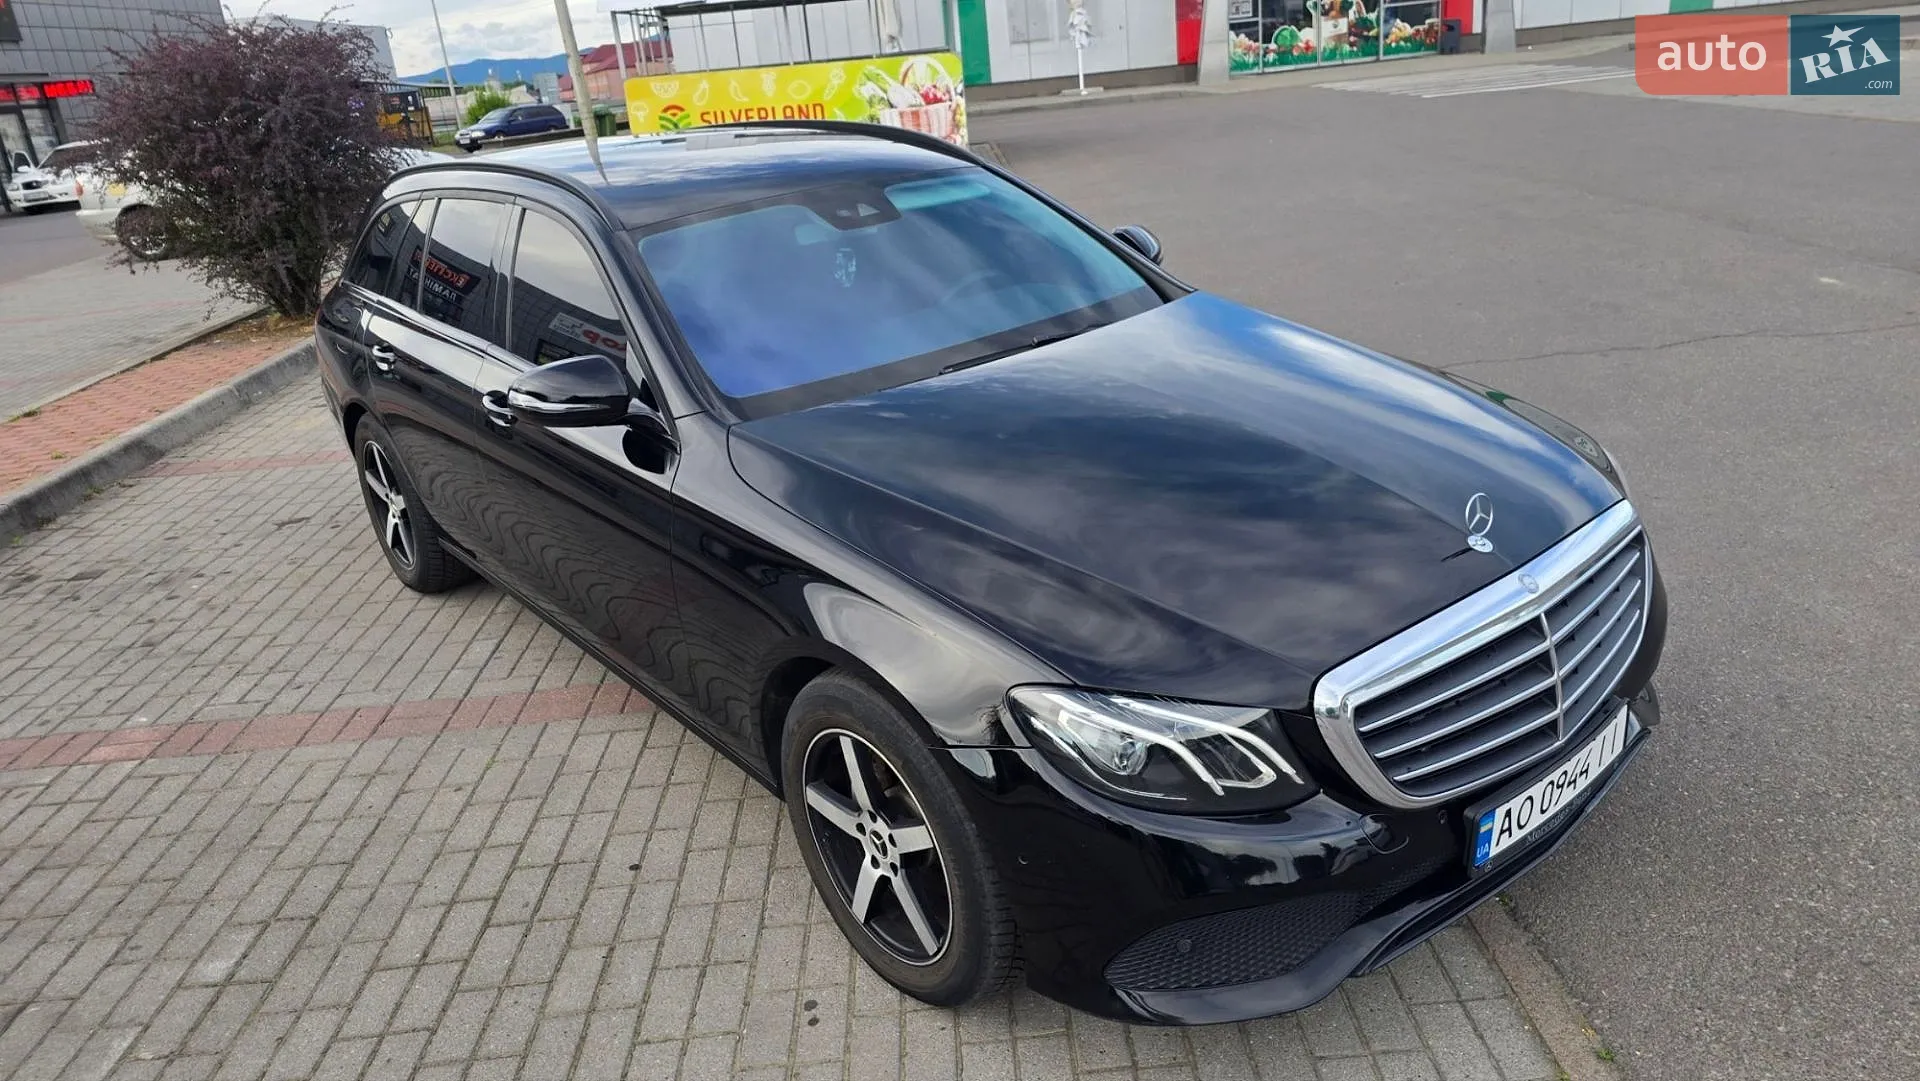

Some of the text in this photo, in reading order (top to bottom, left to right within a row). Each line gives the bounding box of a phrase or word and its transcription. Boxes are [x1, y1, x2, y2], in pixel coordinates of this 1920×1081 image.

[1495, 795, 1534, 847] AO
[1539, 747, 1592, 815] 0944
[1476, 844, 1489, 858] UA
